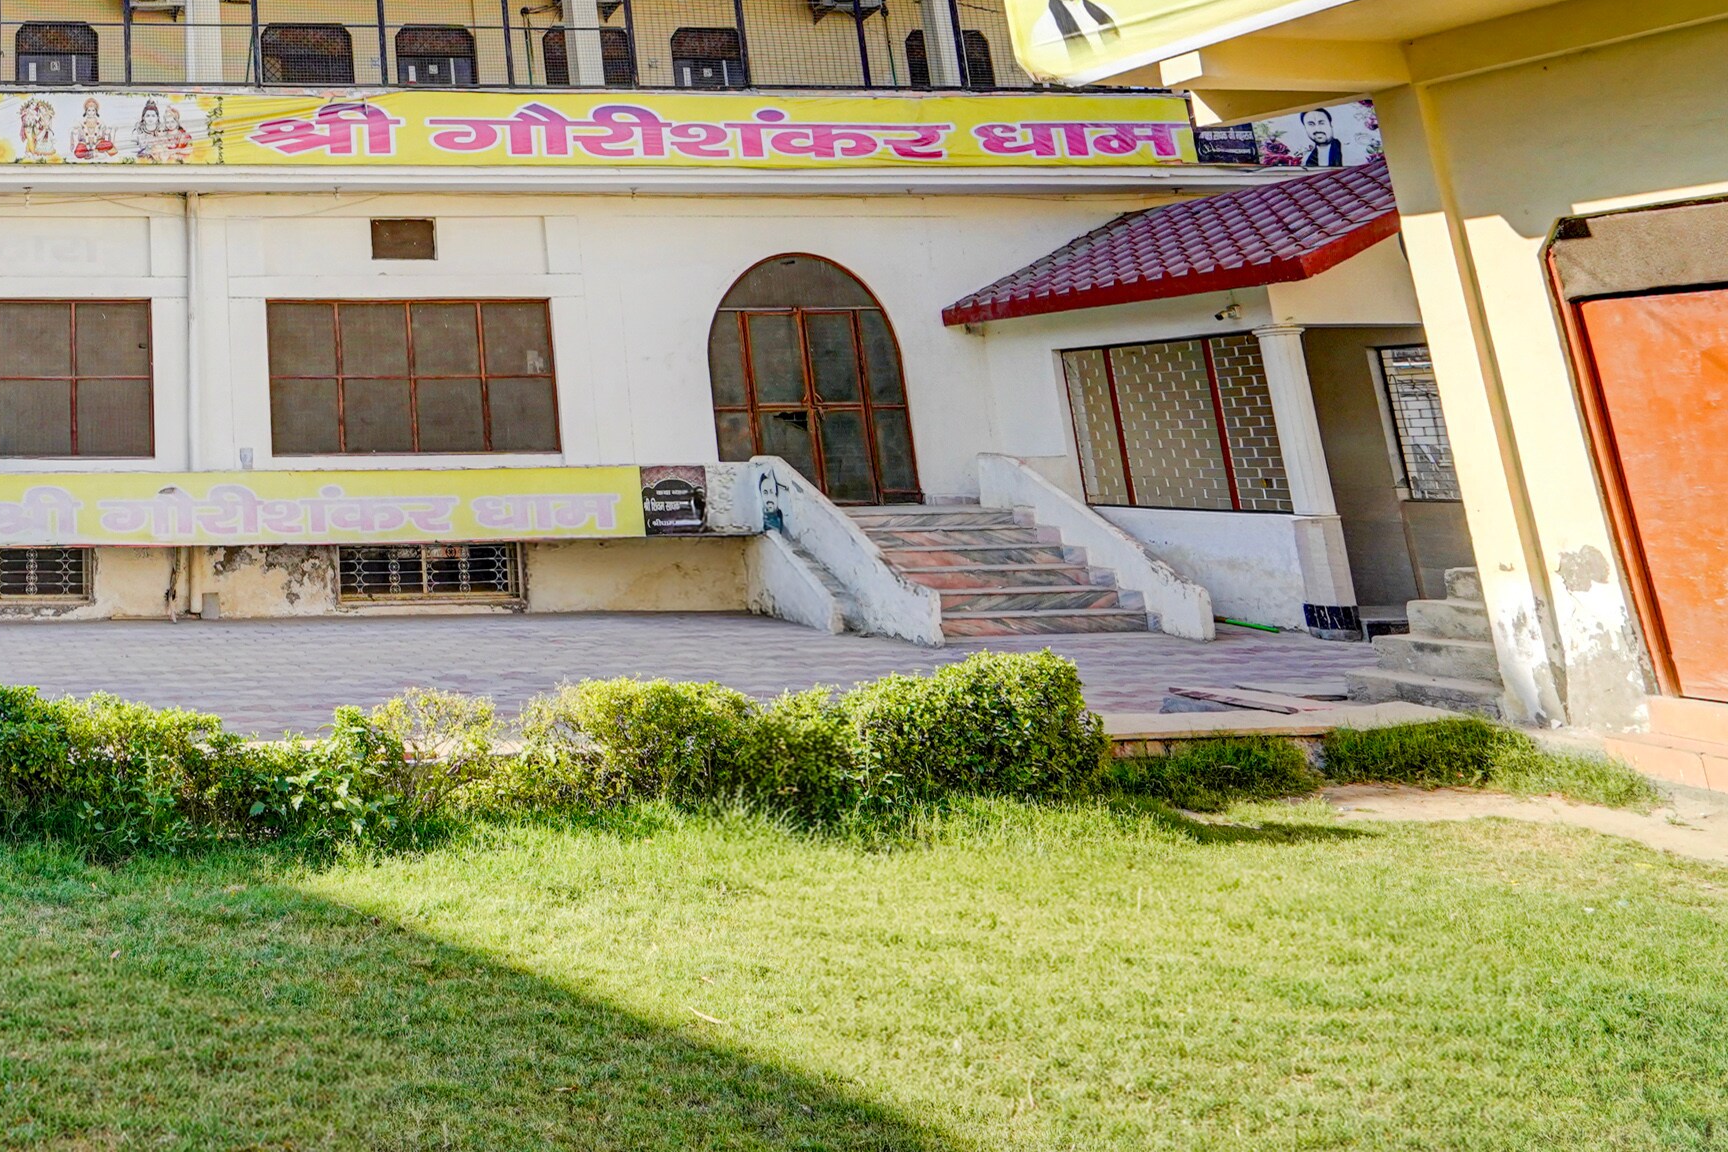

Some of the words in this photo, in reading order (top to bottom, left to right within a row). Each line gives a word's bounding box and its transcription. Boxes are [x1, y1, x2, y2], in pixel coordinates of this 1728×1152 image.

[248, 101, 405, 157] श्री
[427, 101, 953, 160] गौरीशंकर
[971, 120, 1191, 157] धाम
[99, 484, 459, 536] गौरीशंकर
[470, 493, 620, 532] धाम
